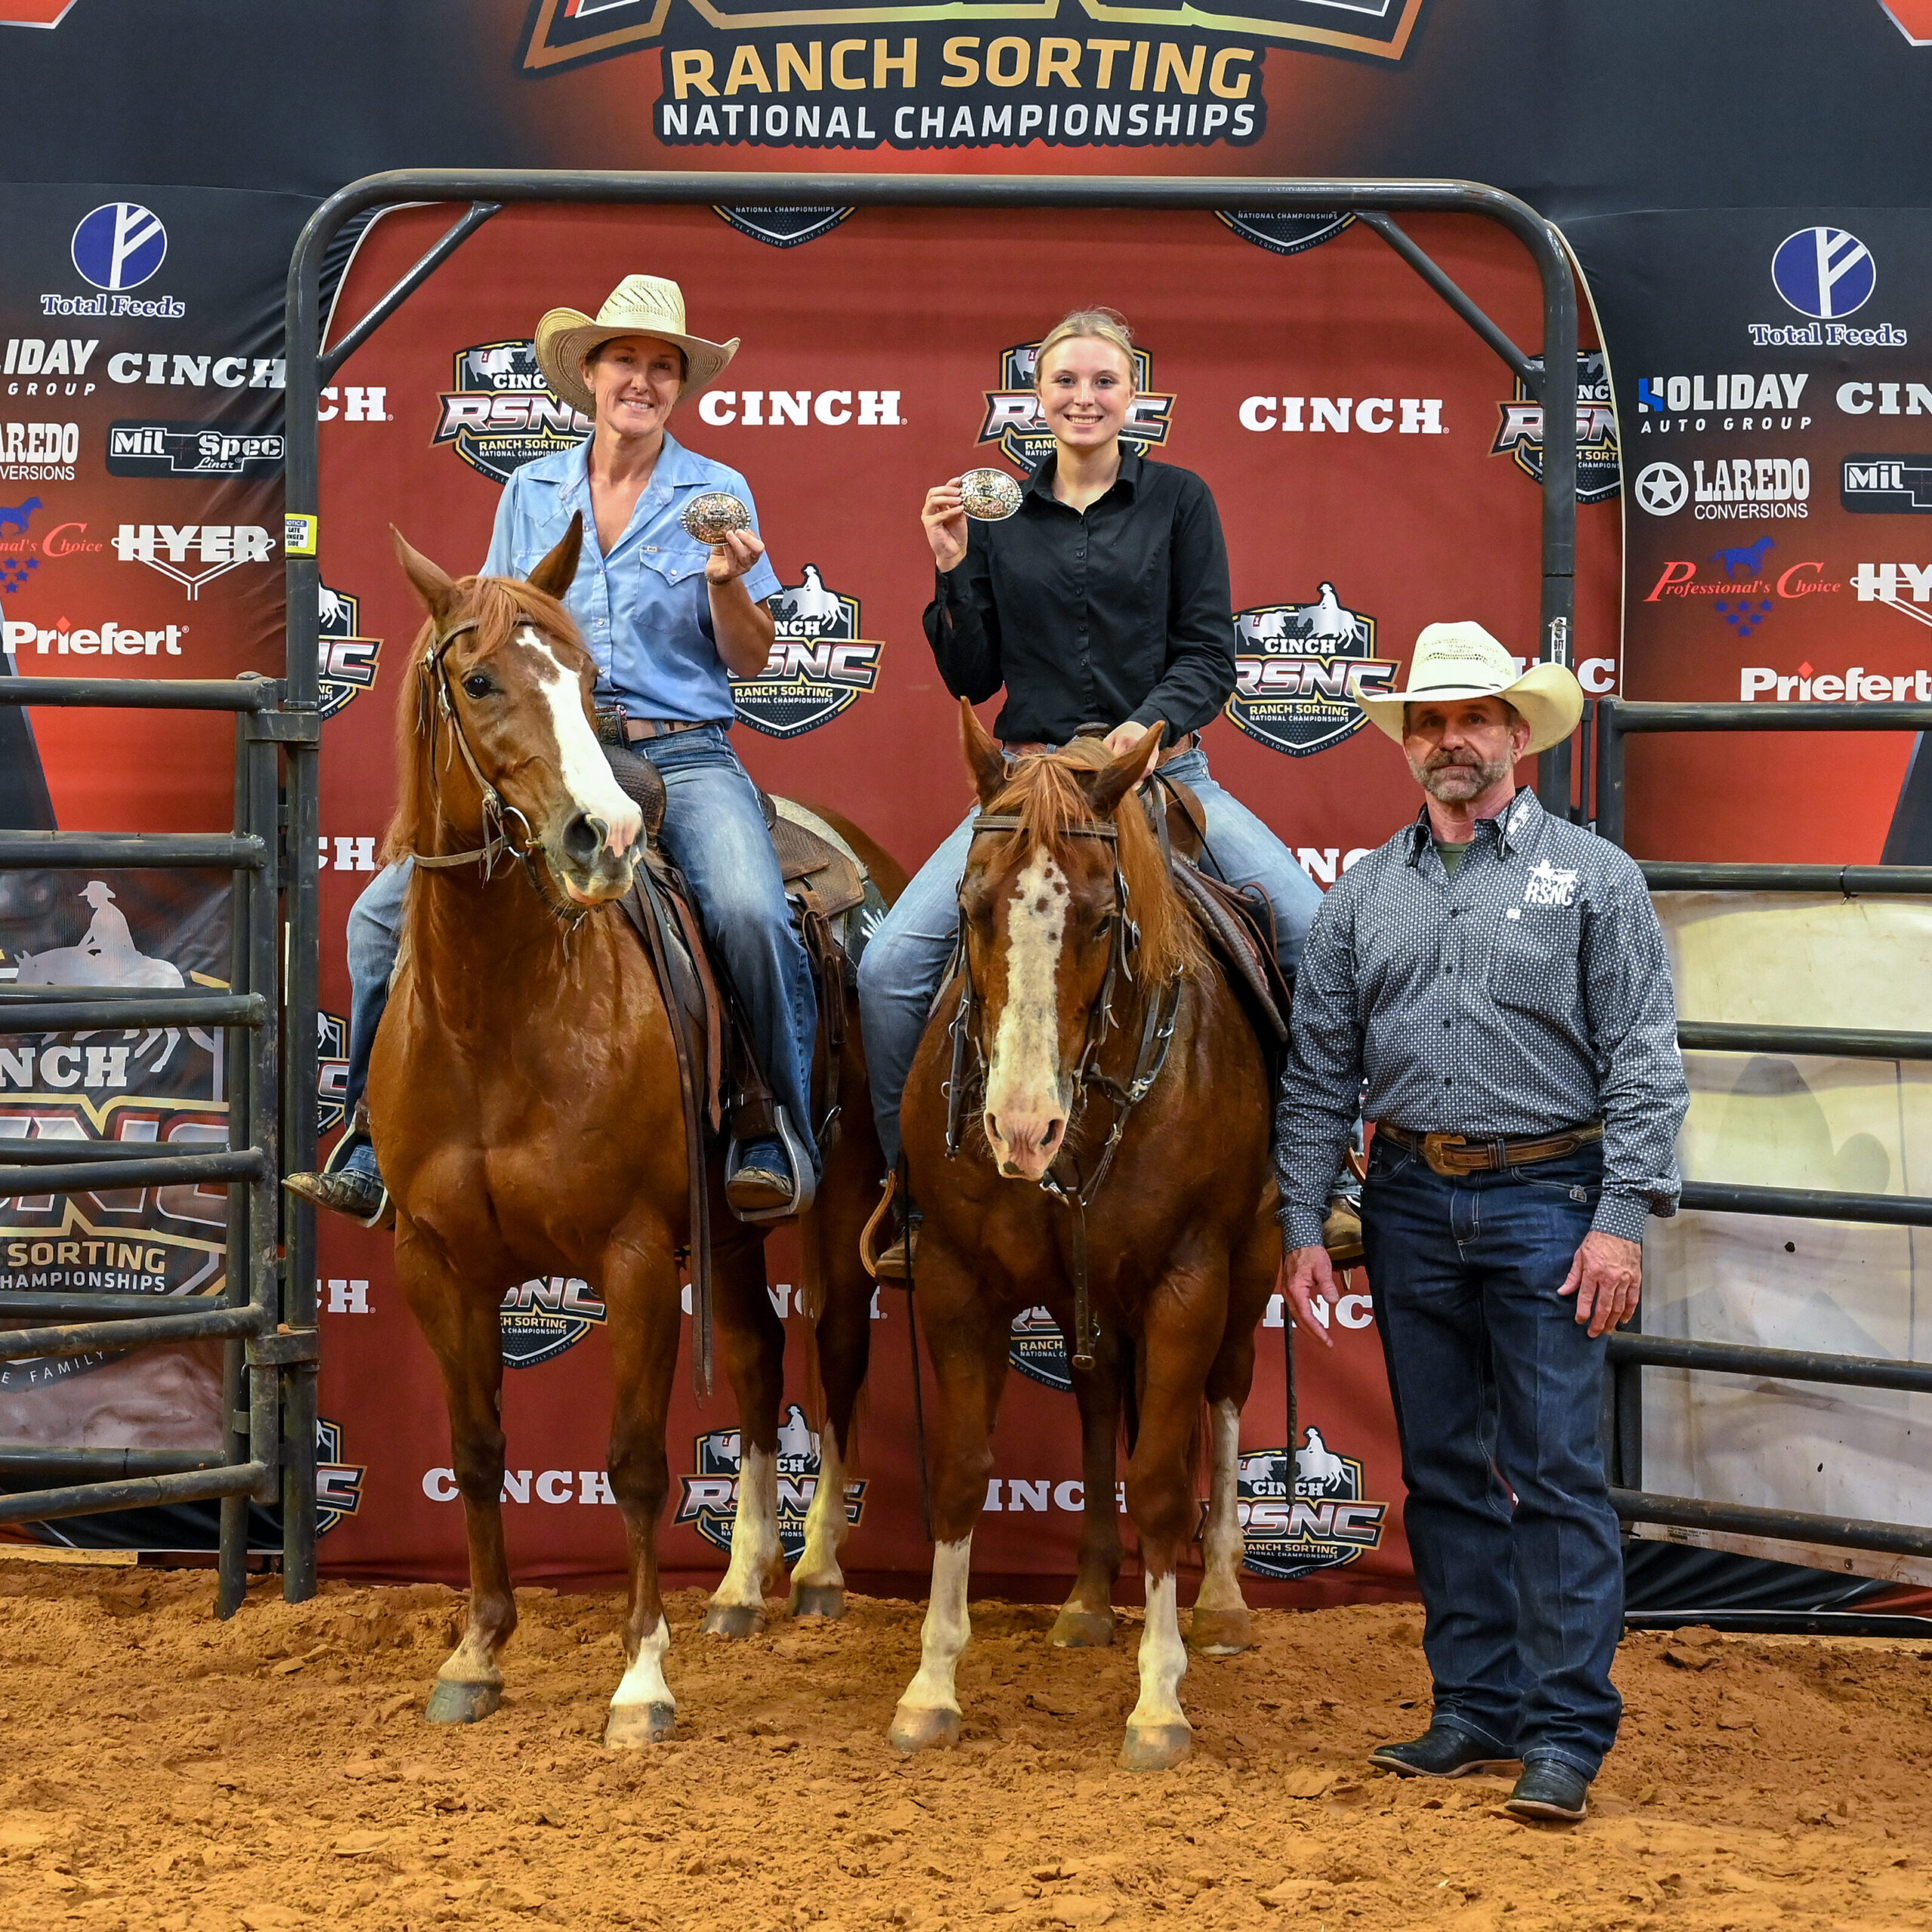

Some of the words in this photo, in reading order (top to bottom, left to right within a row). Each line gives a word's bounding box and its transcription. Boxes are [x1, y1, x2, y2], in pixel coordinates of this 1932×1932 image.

[672, 37, 915, 100] RANCH
[940, 36, 1256, 100] SORTING
[663, 103, 875, 140] NATIONAL
[893, 103, 1256, 138] CHAMPIONSHIPS
[41, 294, 107, 315] Total
[111, 295, 185, 317] Feeds
[1749, 324, 1821, 345] Total
[1826, 324, 1906, 346] Feeds
[0, 340, 99, 375] IDAY
[107, 353, 286, 389] CINCH
[493, 374, 547, 389] CINC
[8, 383, 97, 396] GROUP
[1638, 374, 1810, 413] HOLIDAY
[1641, 418, 1705, 434] AUTO
[1724, 417, 1811, 431] GROUP
[113, 431, 165, 454] Mil
[198, 435, 281, 460] Spec
[479, 440, 521, 451] RANCH
[1586, 451, 1619, 460] SORT
[0, 466, 75, 481] VERSIONS
[1694, 457, 1810, 503] LAREDO
[1848, 466, 1903, 489] Mil
[1694, 504, 1809, 519] CONVERSIONS
[42, 523, 103, 558] Choice
[118, 525, 271, 562] HYER
[1643, 561, 1770, 601] Professional's
[1776, 562, 1841, 598] Choice
[1264, 638, 1337, 654] CINCH
[727, 644, 876, 684] SNC
[734, 686, 777, 697] RANCH
[780, 686, 834, 697] SORTING
[1740, 661, 1932, 701] Priefert
[1250, 704, 1293, 715] RANCH
[1297, 704, 1349, 716] SORTING
[1524, 881, 1576, 906] RSNC
[8, 1241, 166, 1274] SORTING
[515, 1317, 567, 1329] SORTING
[1020, 1340, 1063, 1351] RANCH
[29, 1351, 104, 1383] FAMILY
[422, 1468, 617, 1504] CNCH
[1278, 1551, 1338, 1559] CHAMPIONSHIPS
[1284, 1543, 1338, 1555] SORTING
